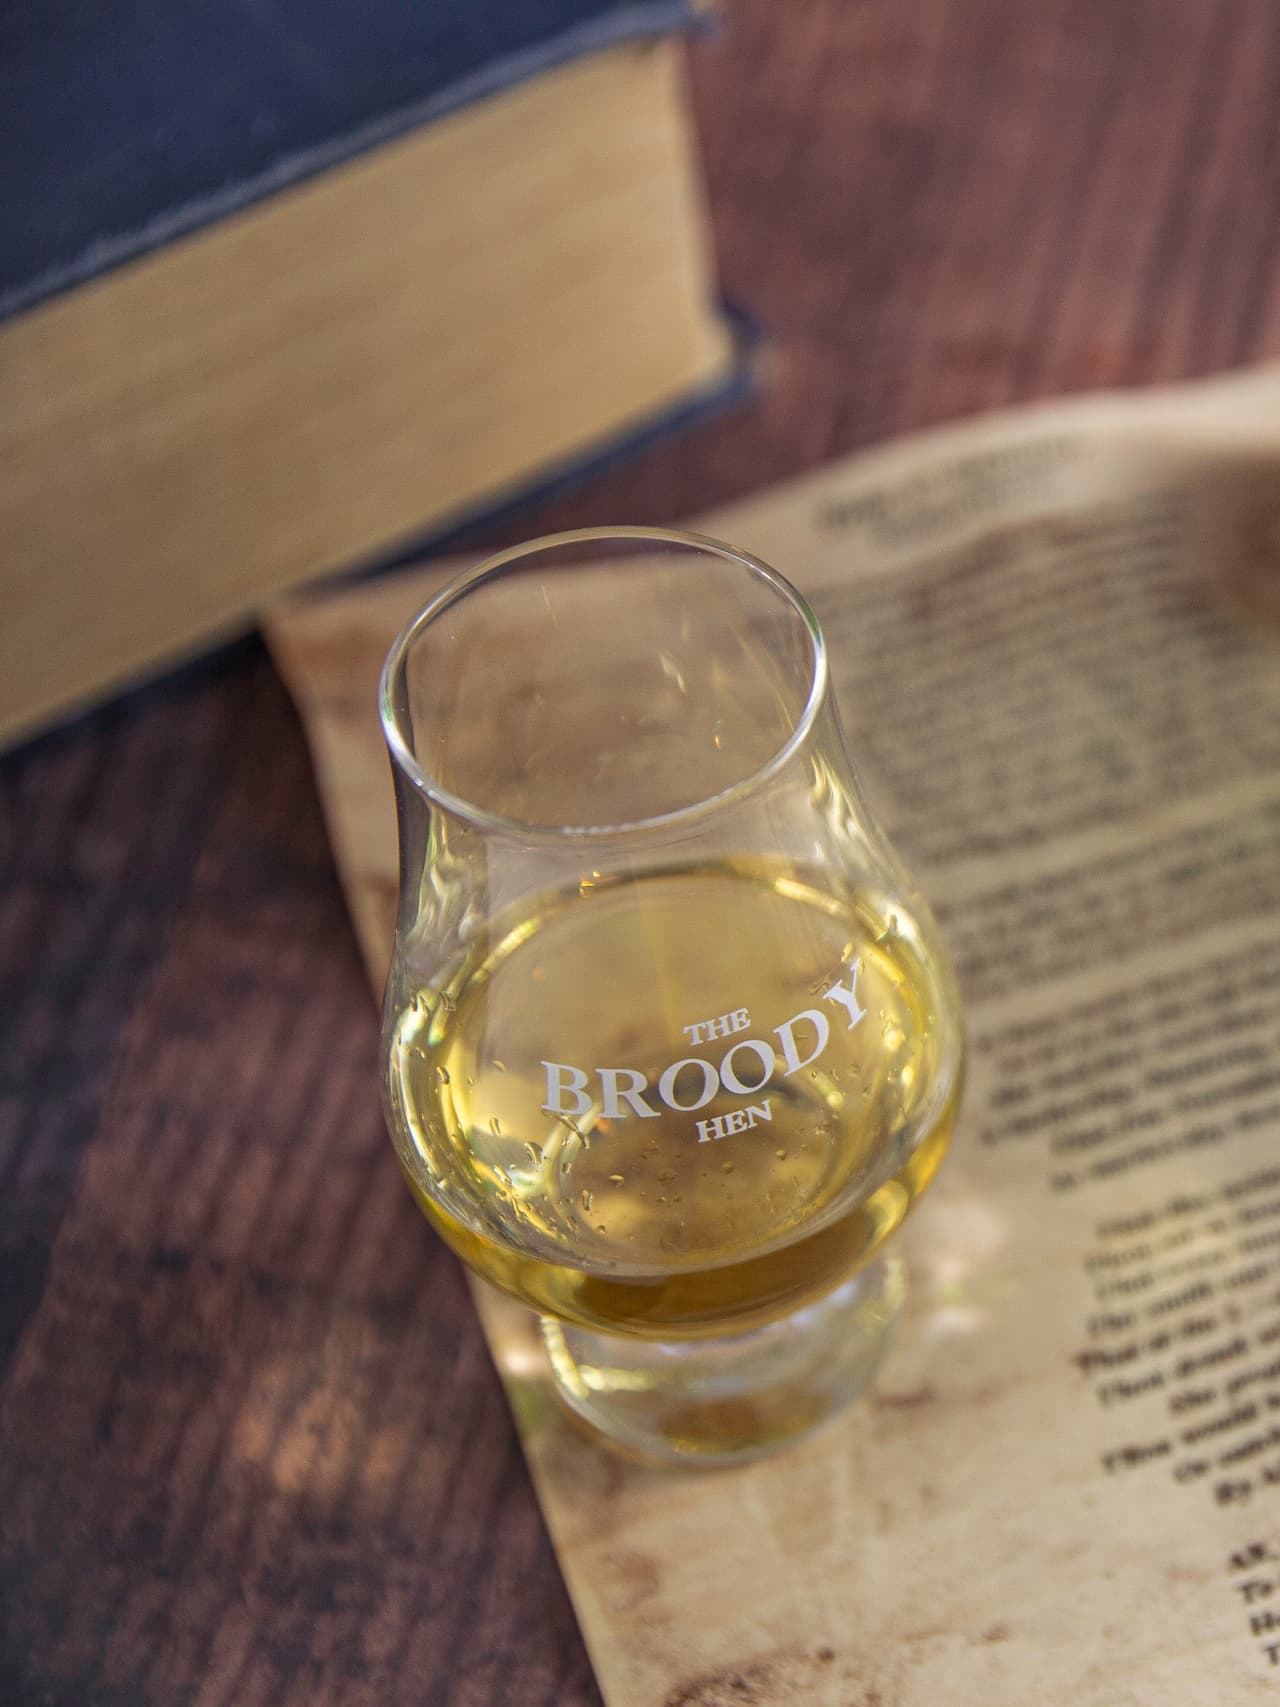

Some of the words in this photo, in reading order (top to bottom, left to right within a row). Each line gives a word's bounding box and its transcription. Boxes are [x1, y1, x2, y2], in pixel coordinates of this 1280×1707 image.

[540, 958, 867, 1119] BROODY
[683, 1008, 751, 1046] THE
[696, 1099, 772, 1143] HEN
